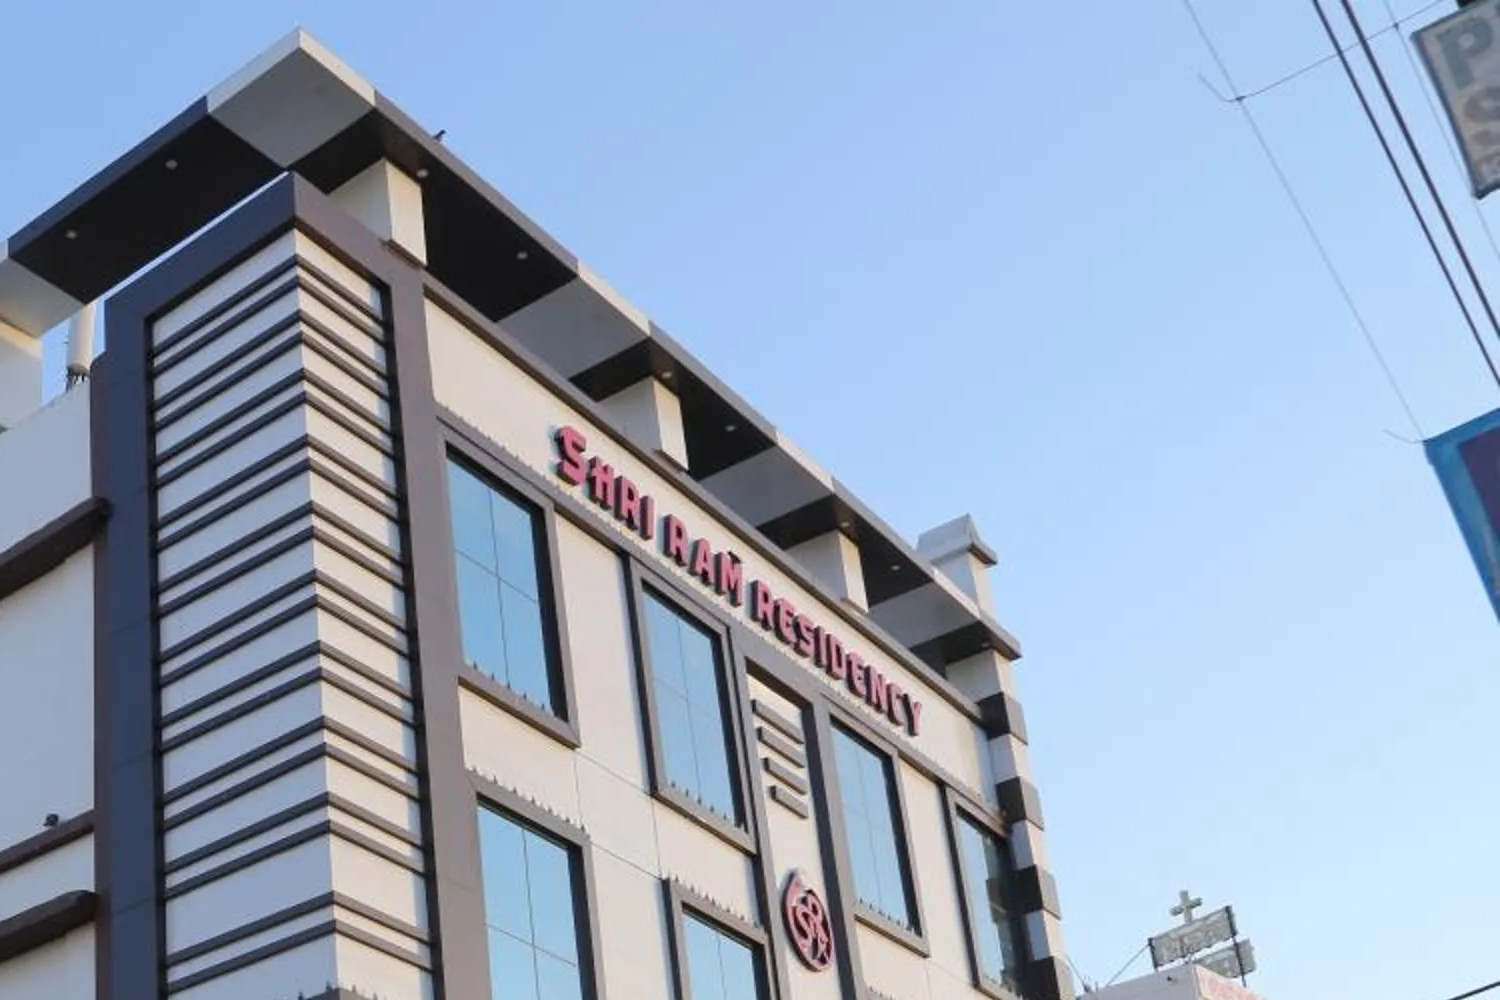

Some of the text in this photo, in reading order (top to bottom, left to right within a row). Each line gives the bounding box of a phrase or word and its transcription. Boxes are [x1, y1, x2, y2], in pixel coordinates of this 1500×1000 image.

[556, 426, 923, 736] SHRI RAM RESIDENCY
